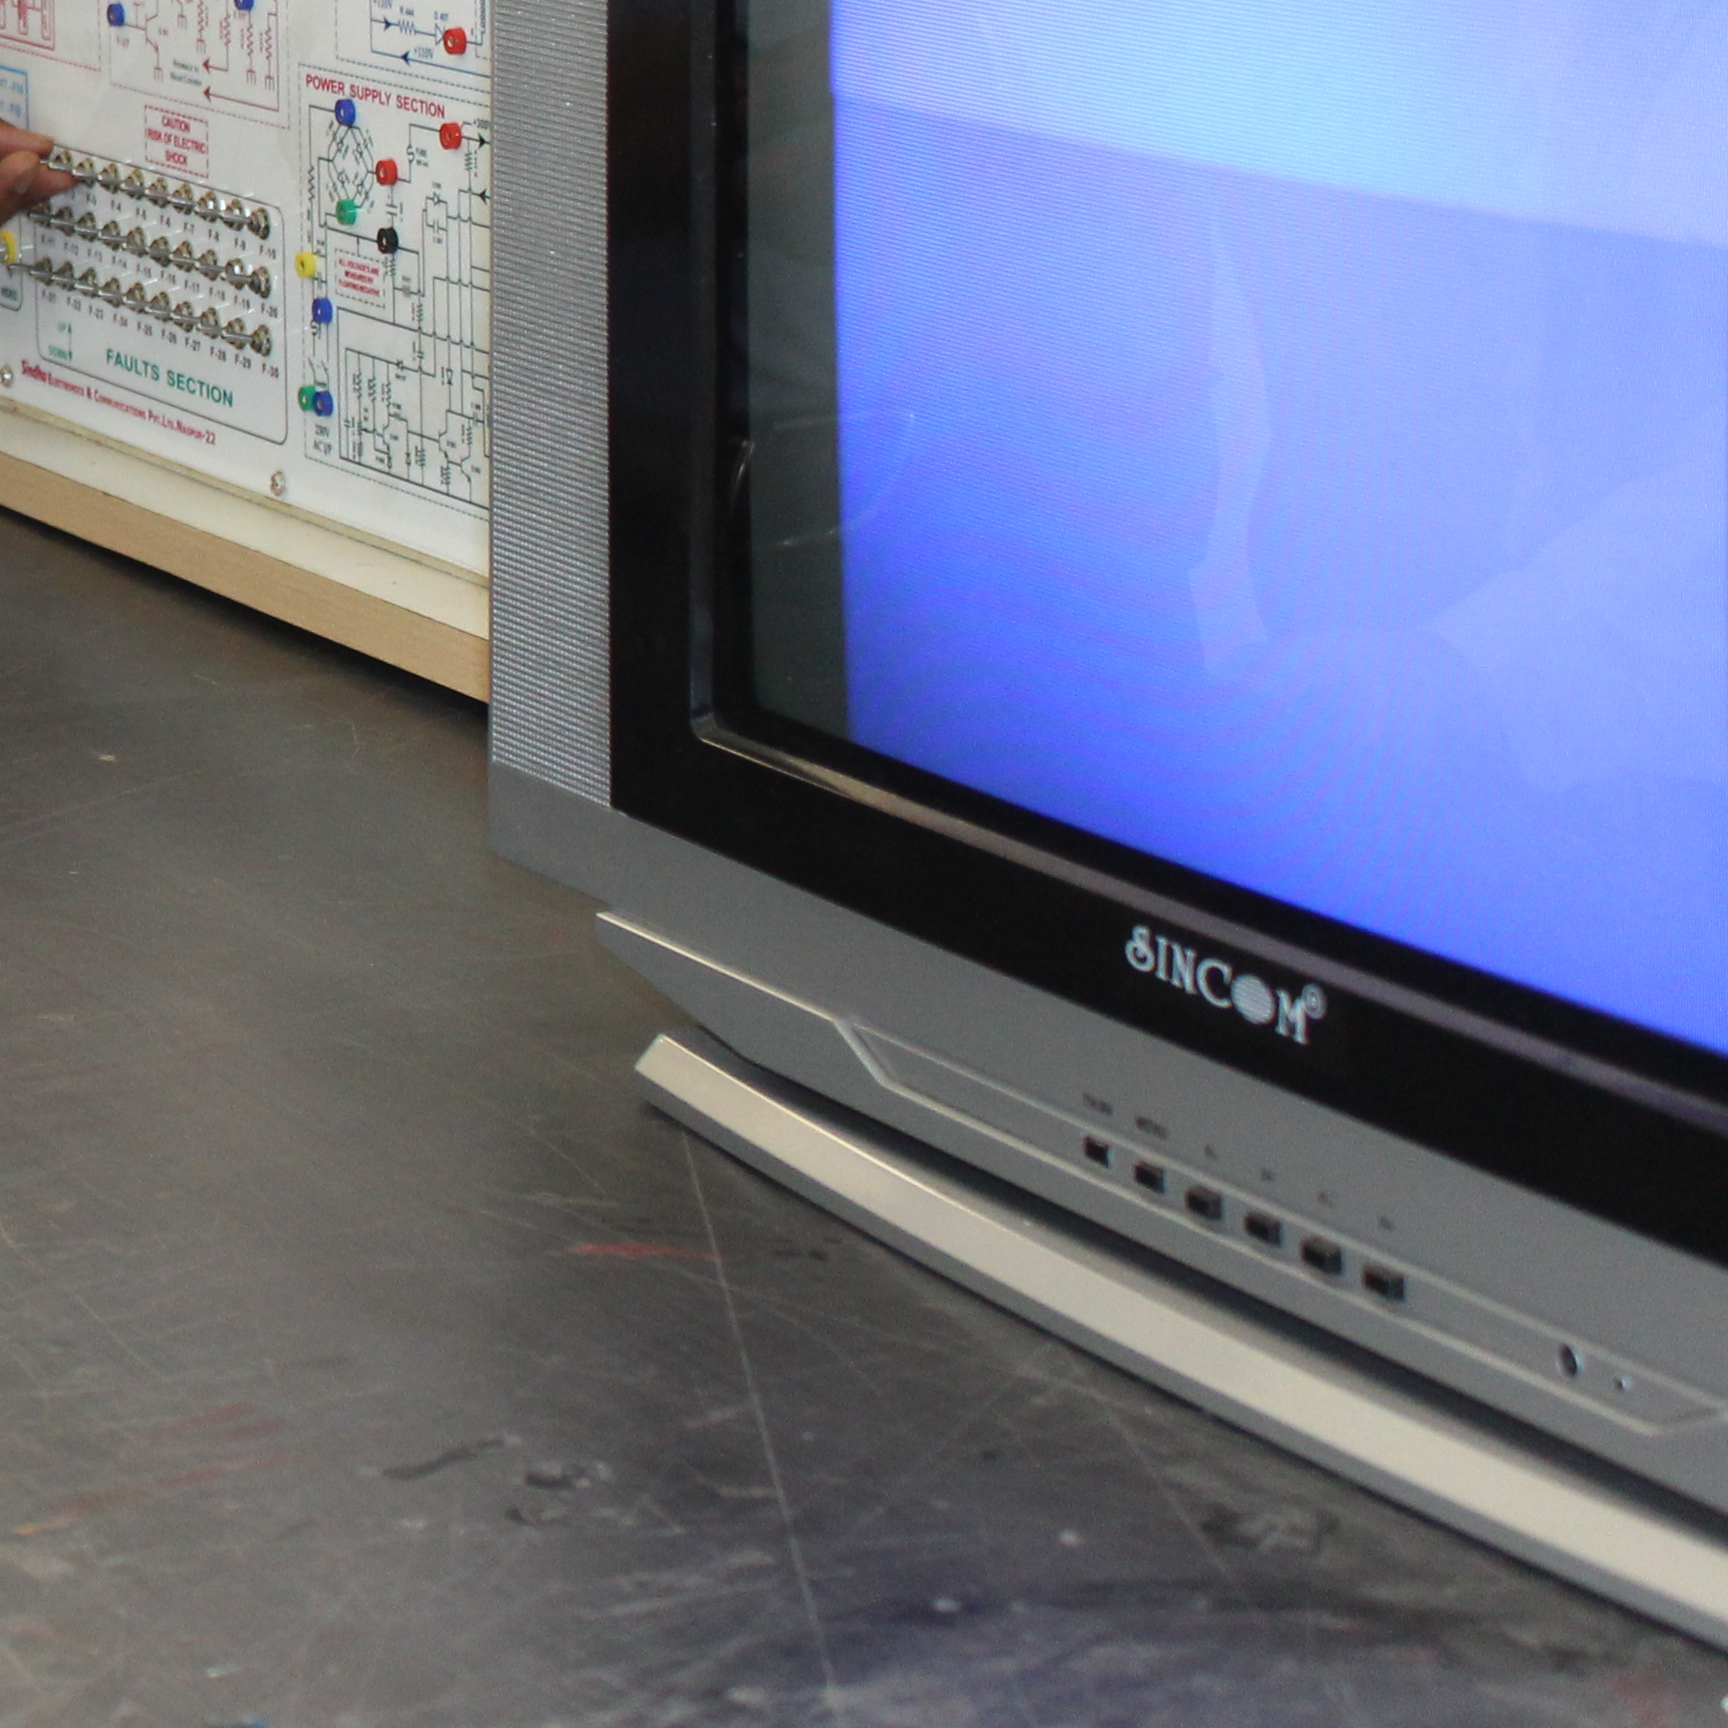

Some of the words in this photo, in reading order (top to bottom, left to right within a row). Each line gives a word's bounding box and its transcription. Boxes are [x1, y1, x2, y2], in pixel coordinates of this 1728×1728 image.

[305, 74, 345, 97] POWER
[350, 84, 392, 107] SUPPLY
[396, 95, 446, 119] SECTION
[161, 115, 191, 133] CAUTION
[106, 348, 161, 382] FAULTS
[166, 369, 234, 408] SECTION
[1125, 925, 1309, 1045] SINCOM
